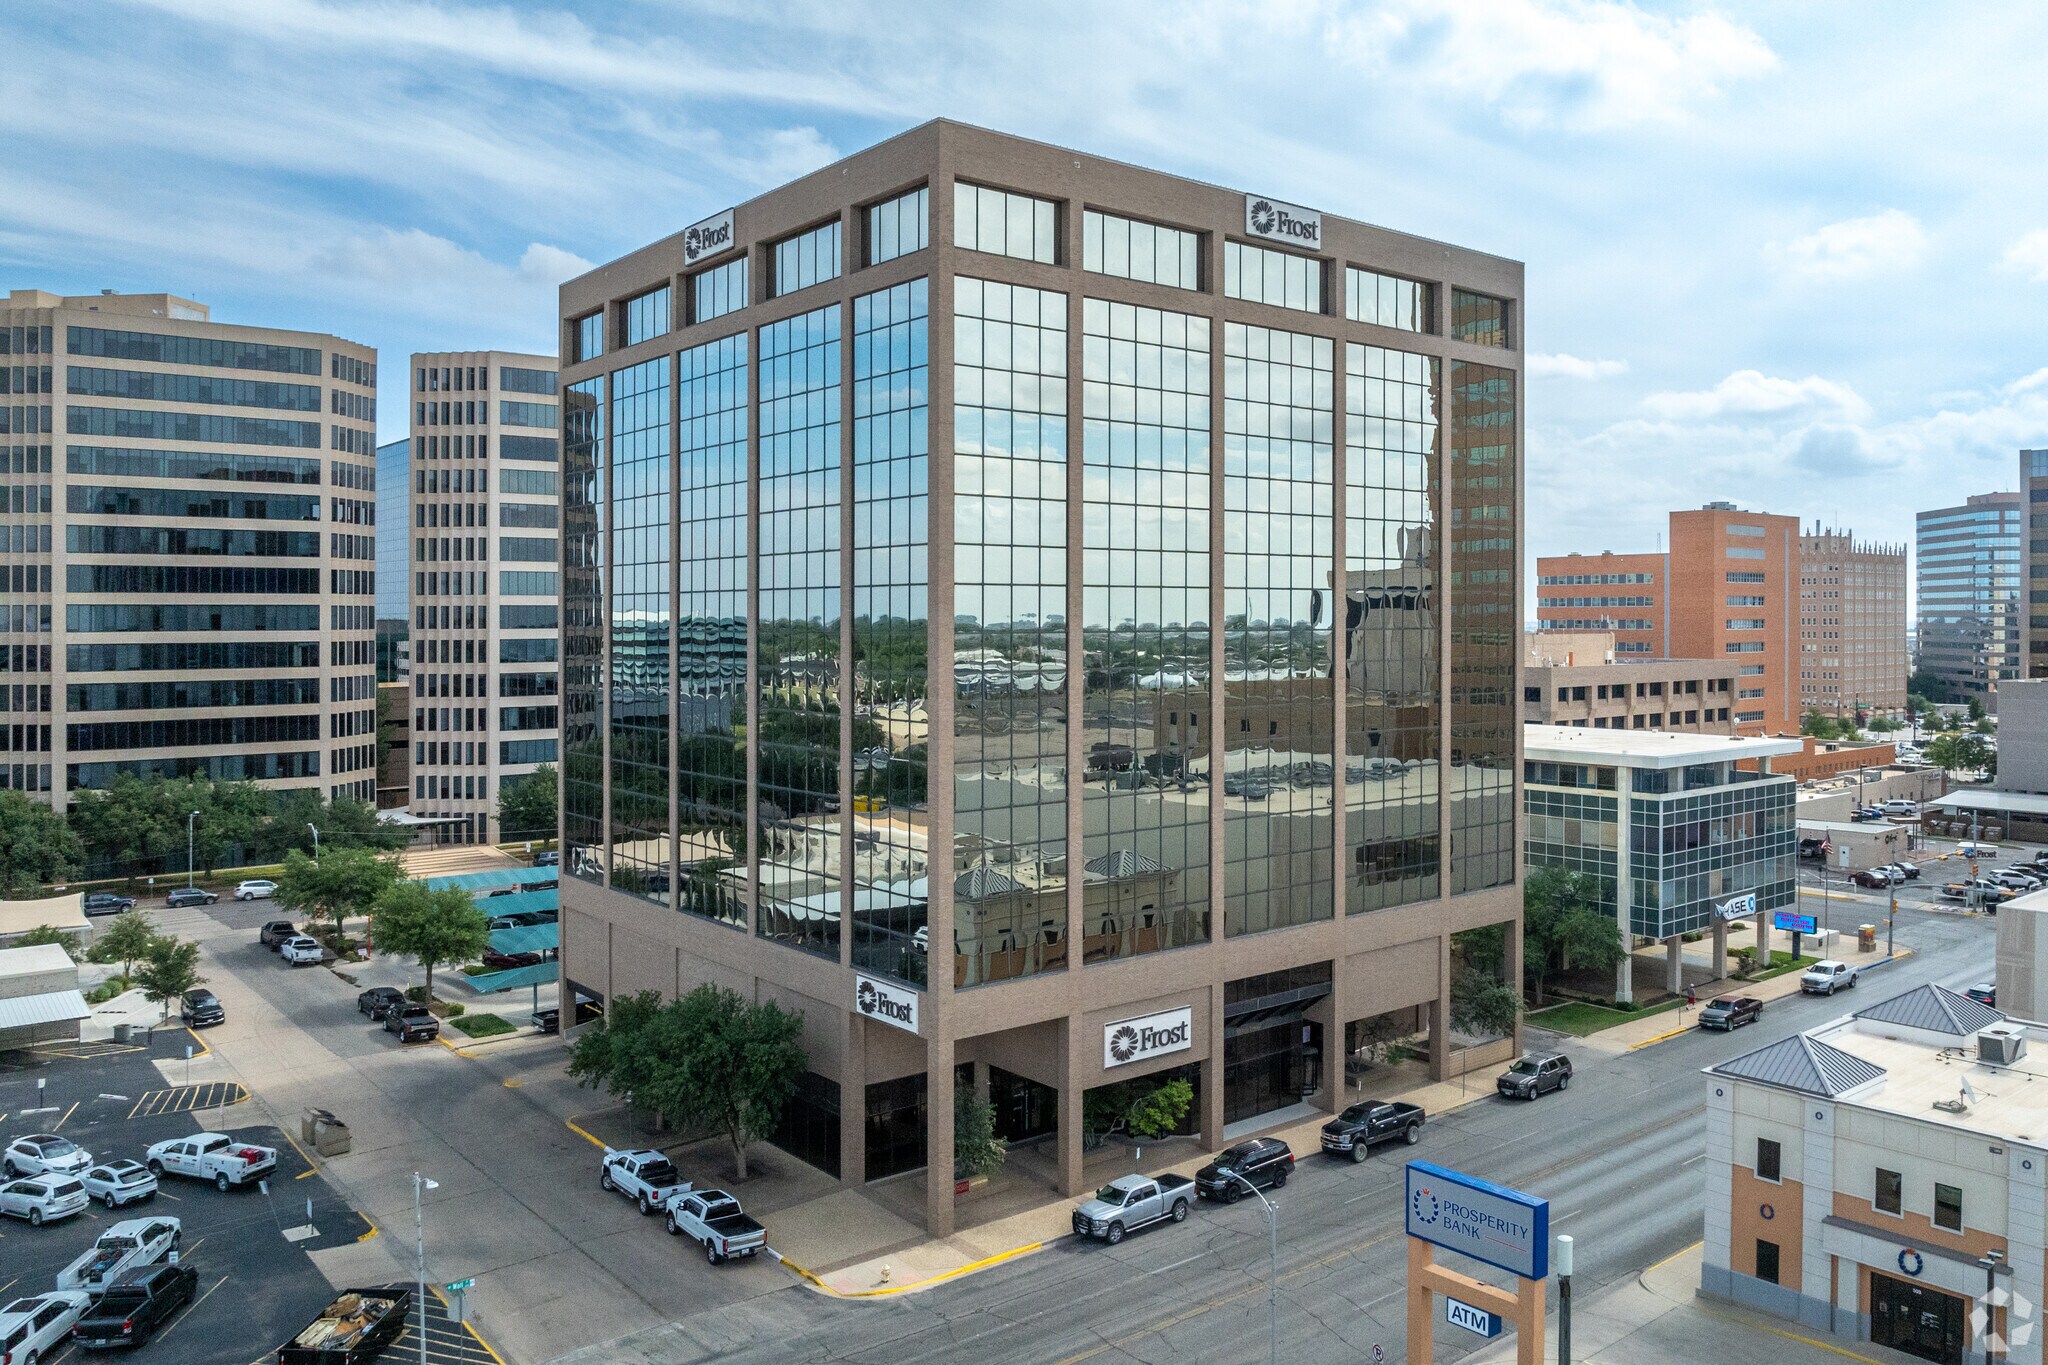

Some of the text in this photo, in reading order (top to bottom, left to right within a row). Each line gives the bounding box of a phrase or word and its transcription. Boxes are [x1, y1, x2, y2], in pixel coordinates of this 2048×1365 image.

[701, 221, 730, 250] Frost
[1277, 210, 1319, 241] Frost
[1977, 850, 1997, 858] Frost
[877, 991, 913, 1024] Frost
[1140, 1021, 1188, 1052] Frost
[1443, 1200, 1529, 1240] PROSPERITY
[1443, 1216, 1481, 1240] BANK
[1452, 1306, 1486, 1332] ATM
